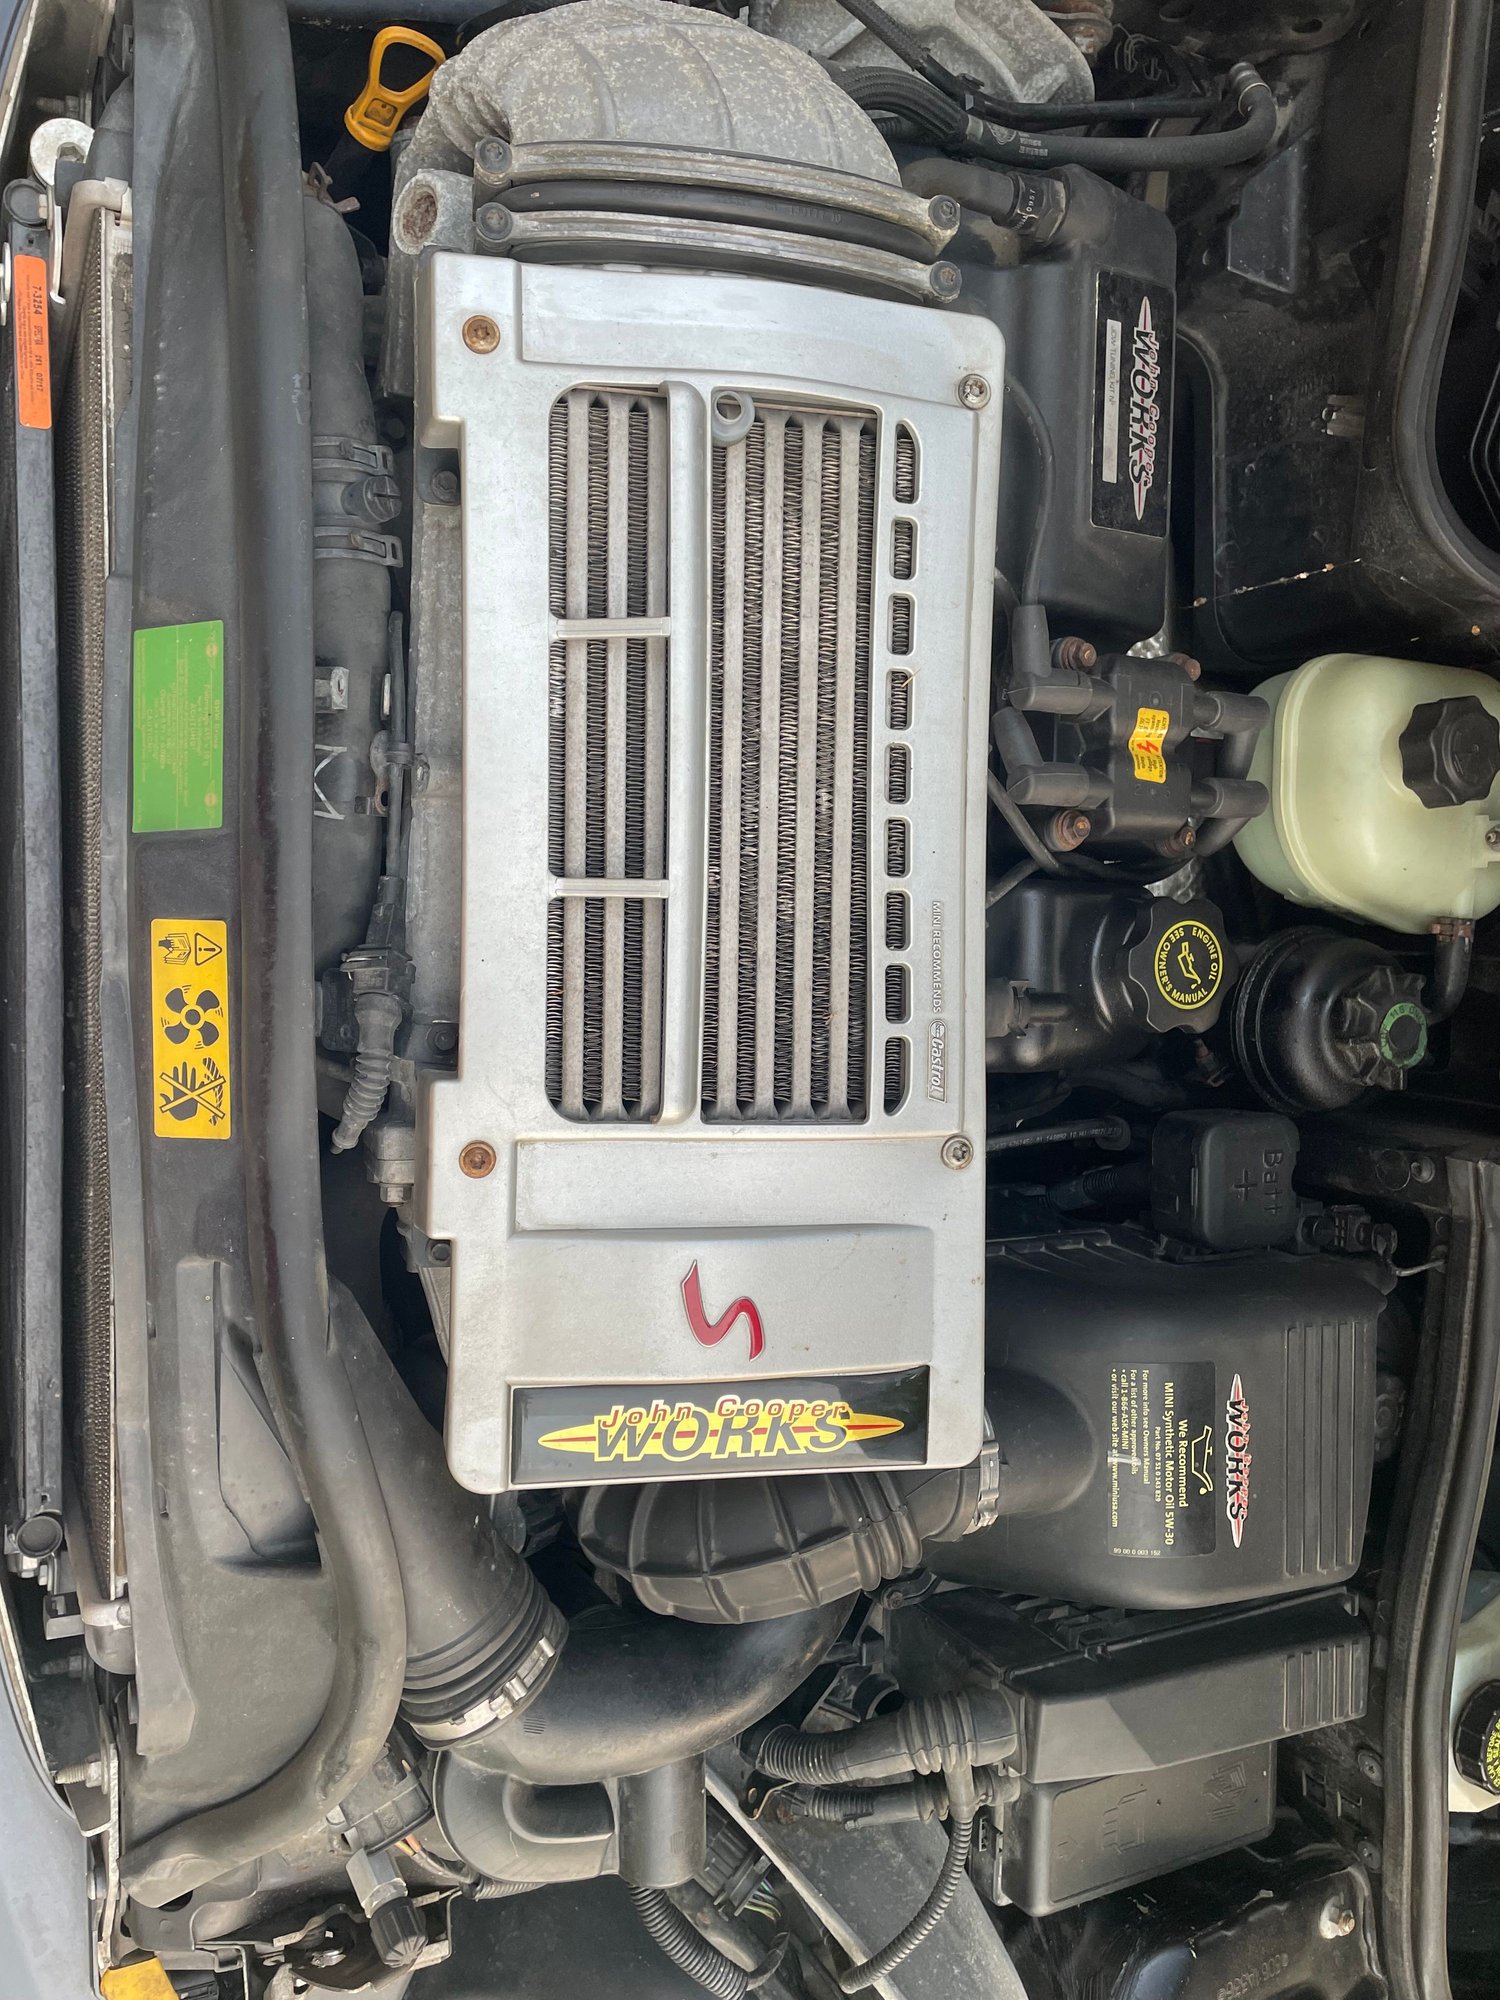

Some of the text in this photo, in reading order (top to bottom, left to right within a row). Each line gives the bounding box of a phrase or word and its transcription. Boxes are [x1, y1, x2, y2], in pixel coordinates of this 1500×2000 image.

[32, 286, 42, 315] 7-3254
[1128, 327, 1156, 488] WORKS
[1143, 334, 1160, 487] John Cooper
[932, 901, 942, 927] MINI
[1159, 928, 1208, 1003] SEE OWNER'S MANUAL
[1192, 927, 1218, 980] ENGINE OIL
[932, 930, 942, 1013] RECOMMENDS
[931, 1038, 945, 1091] Castrol
[1262, 1150, 1283, 1215] Batt
[1111, 1373, 1118, 1382] or
[1130, 1370, 1138, 1381] For
[1142, 1370, 1150, 1381] For
[1130, 1388, 1138, 1398] list
[1130, 1400, 1138, 1408] of
[602, 1398, 848, 1429] John Cooper
[1120, 1374, 1128, 1450] call 1-866-ASK-MINI
[1130, 1409, 1138, 1428] other
[1142, 1402, 1150, 1416] info
[1240, 1401, 1252, 1446] John
[596, 1404, 851, 1460] WORKS
[1128, 1430, 1138, 1461] approved
[1142, 1430, 1150, 1456] Owners
[1142, 1458, 1150, 1484] Manual
[1154, 1452, 1161, 1461] 07
[1154, 1462, 1161, 1470] 51
[1162, 1382, 1174, 1546] MINI Synthetic Motor Oil 5W-30
[1178, 1420, 1188, 1508] We Recommend
[1226, 1399, 1247, 1521] WORKS
[1486, 1730, 1497, 1762] BEFORE
